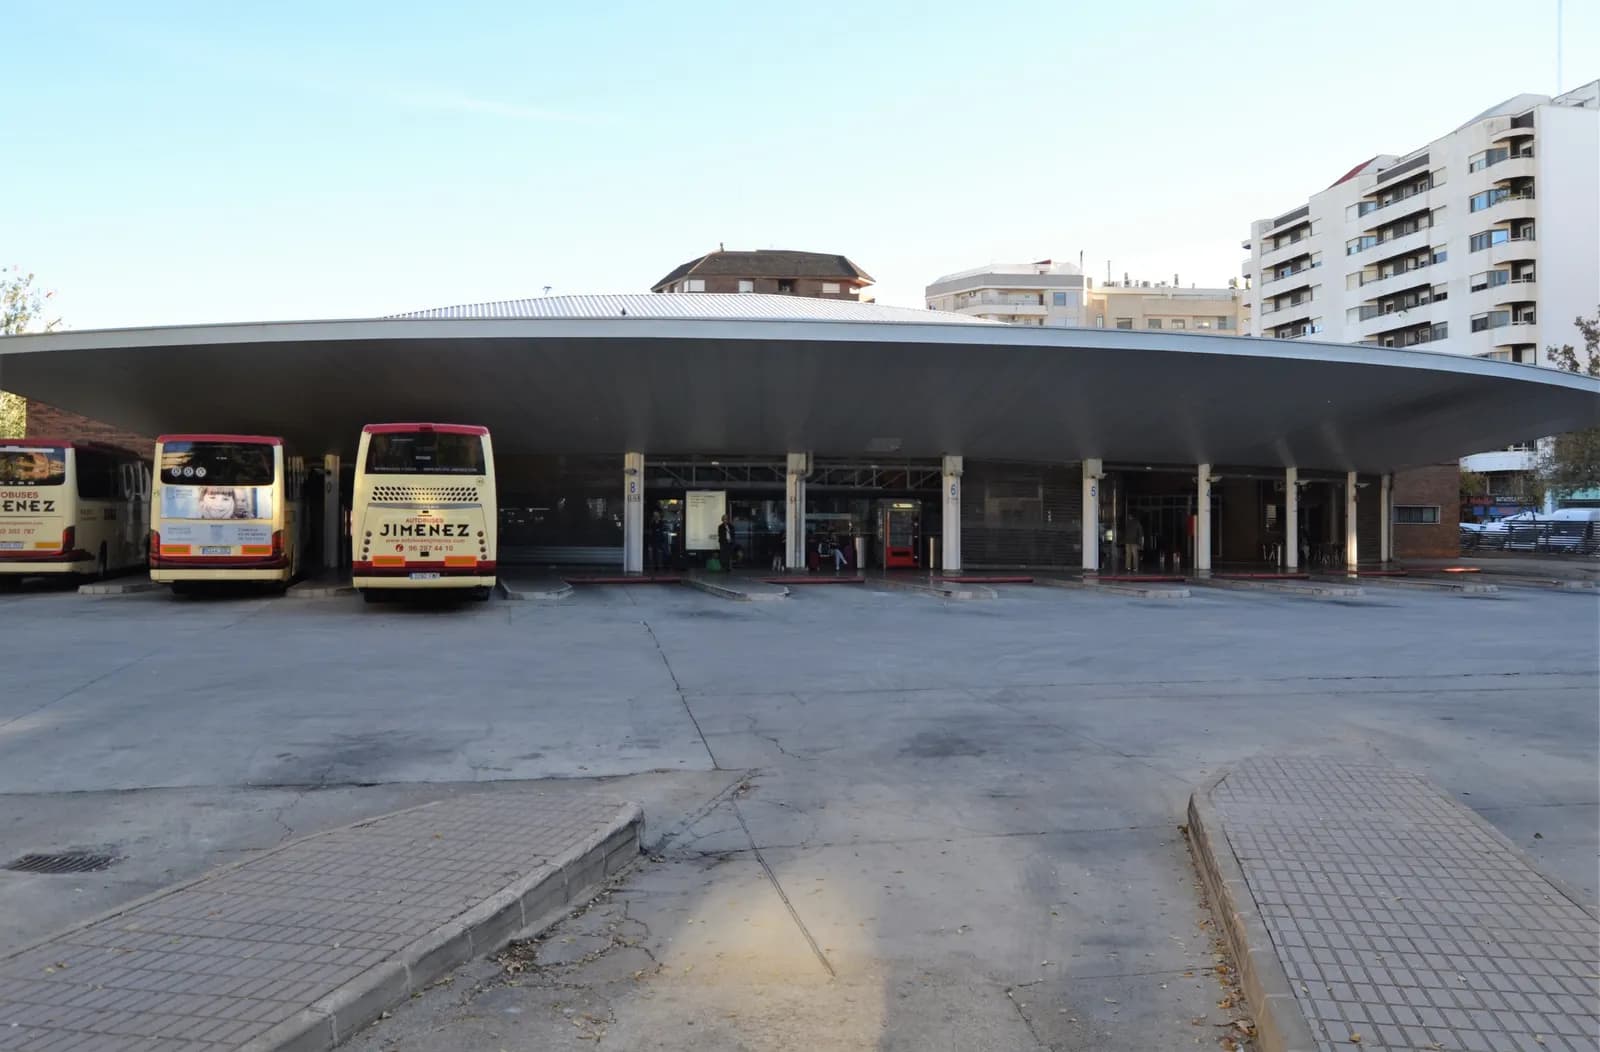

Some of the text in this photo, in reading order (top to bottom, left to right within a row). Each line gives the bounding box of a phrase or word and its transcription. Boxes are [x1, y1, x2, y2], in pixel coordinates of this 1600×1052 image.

[951, 484, 956, 496] 6
[1091, 486, 1097, 497] 5
[2, 500, 55, 512] ENEZ
[380, 523, 470, 537] JIMENEZ
